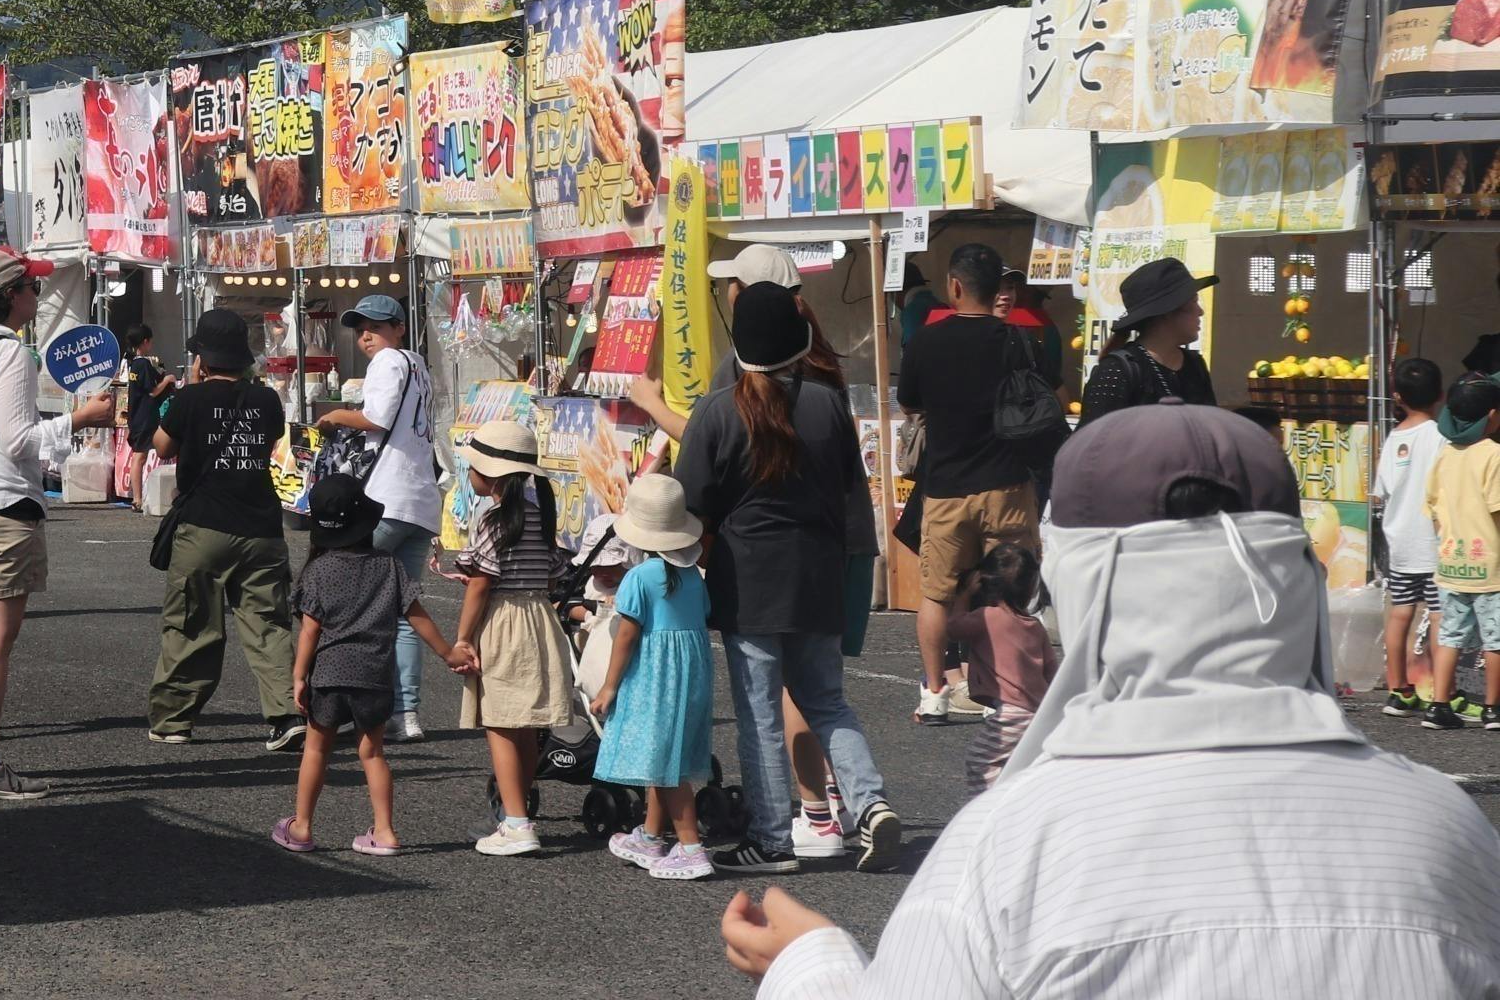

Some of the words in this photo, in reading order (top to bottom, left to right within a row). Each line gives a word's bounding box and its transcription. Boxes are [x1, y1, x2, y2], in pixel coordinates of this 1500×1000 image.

[544, 52, 583, 82] SUPER
[534, 98, 588, 170] ロング
[534, 178, 559, 204] LONG
[540, 203, 577, 231] POTATO
[54, 332, 104, 361] がんばれ!
[63, 374, 75, 385] GO
[74, 370, 86, 381] GO
[85, 359, 113, 377] JAPAN!
[213, 407, 224, 419] IT
[220, 445, 252, 457] UNTIL
